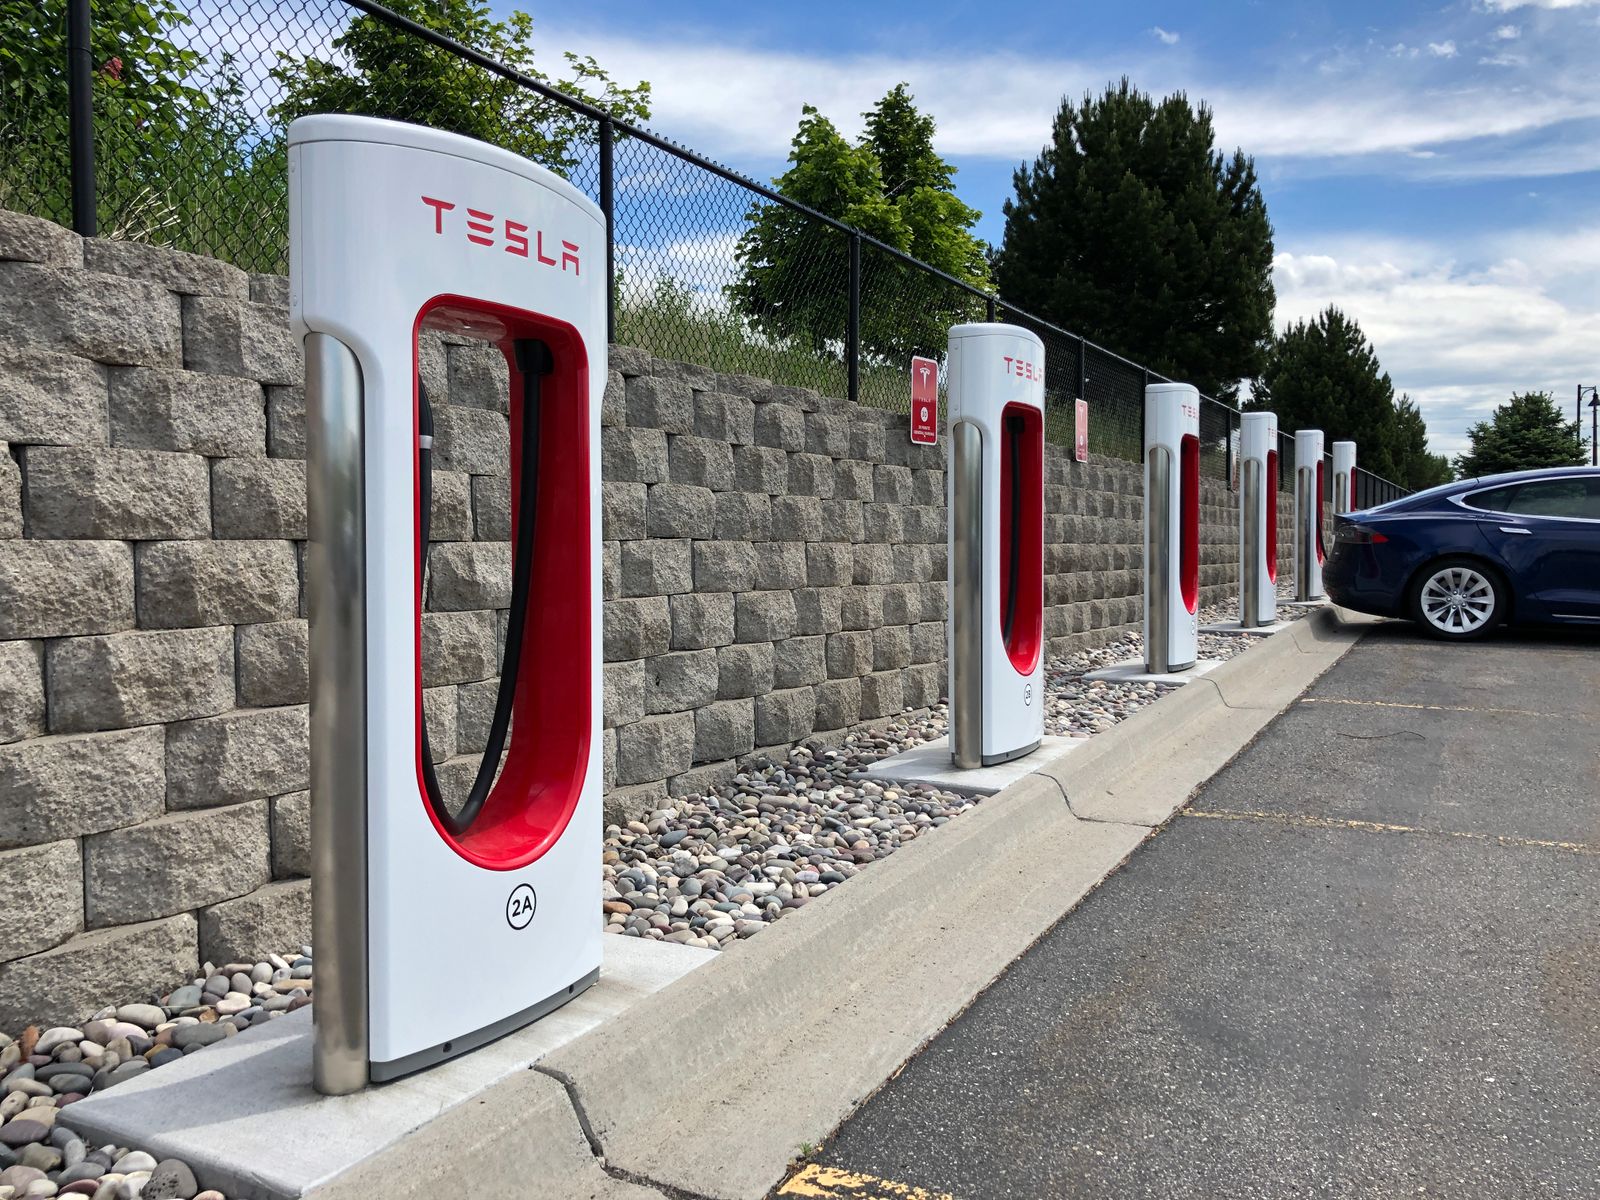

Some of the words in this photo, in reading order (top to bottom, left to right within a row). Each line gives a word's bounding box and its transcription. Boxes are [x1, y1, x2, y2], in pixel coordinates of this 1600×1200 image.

[421, 195, 580, 276] TESLA
[1003, 356, 1043, 384] TESLA
[512, 895, 533, 917] 2A
